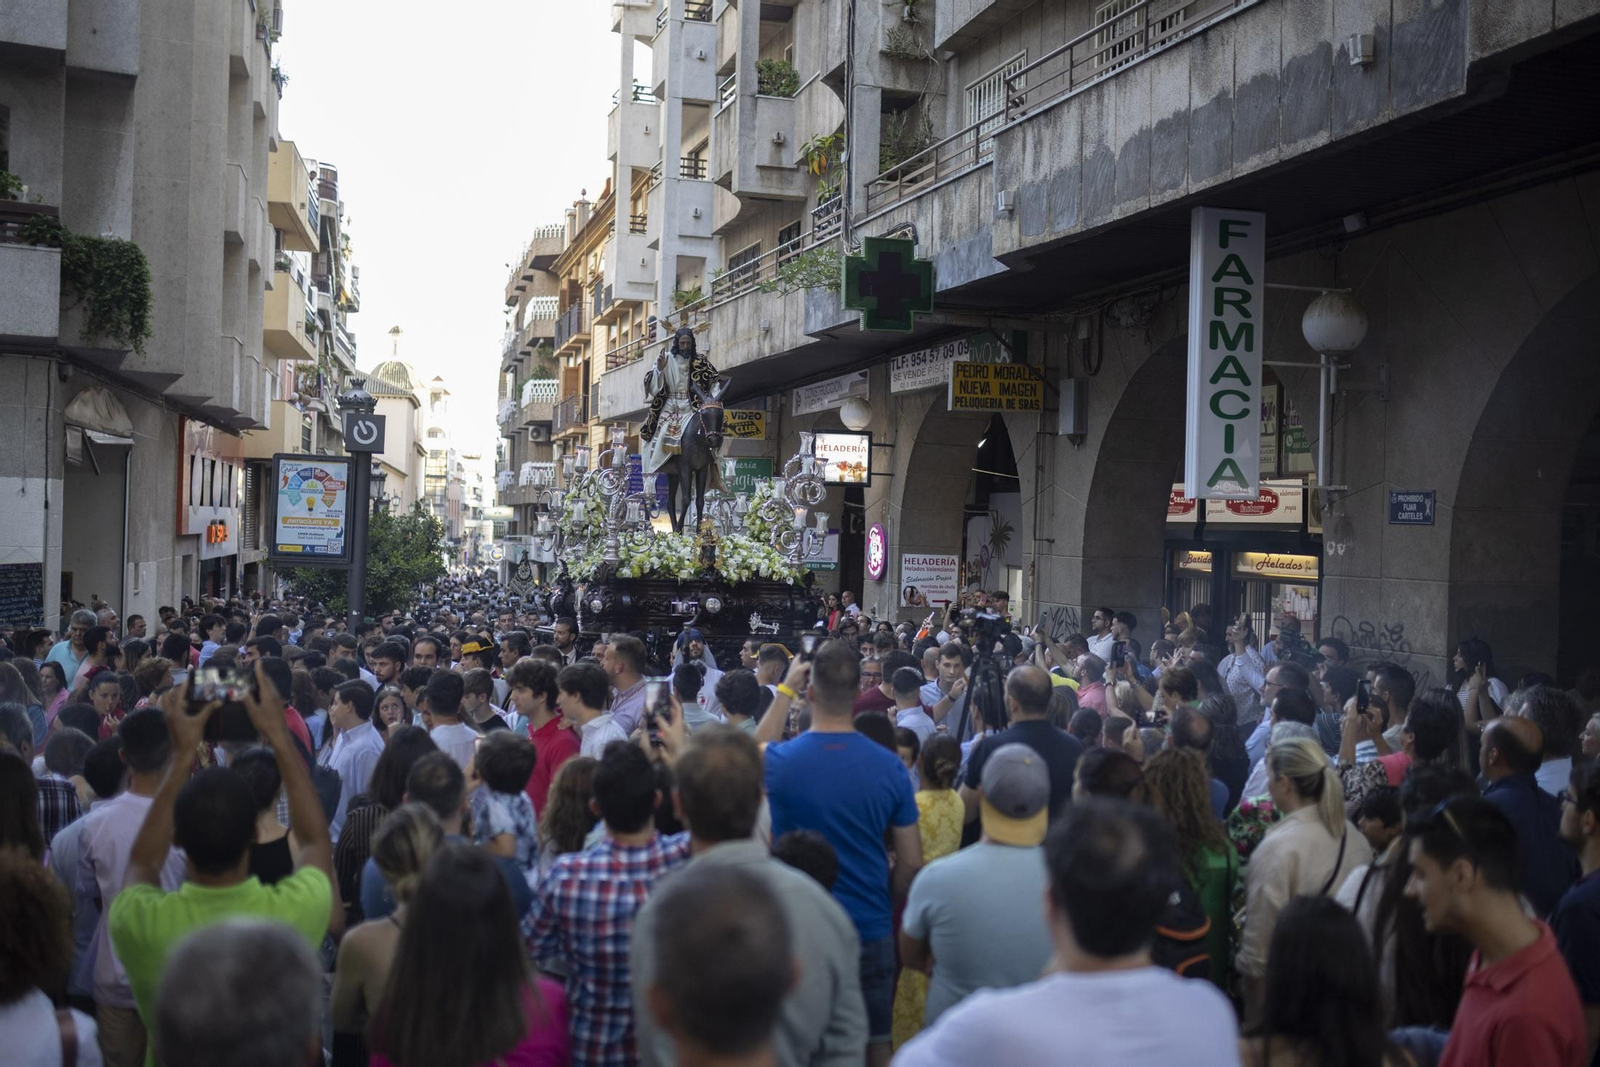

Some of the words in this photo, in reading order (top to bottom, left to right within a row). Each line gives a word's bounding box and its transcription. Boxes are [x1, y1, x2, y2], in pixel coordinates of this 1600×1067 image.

[891, 358, 909, 371] TLF:
[911, 353, 926, 367] 954
[929, 350, 940, 362] 57
[943, 345, 955, 359] 09
[957, 341, 969, 356] 09
[1206, 219, 1254, 489] FARMACIA
[893, 372, 902, 382] SE
[903, 368, 926, 380] VENDE
[956, 364, 989, 379] PEDRO
[994, 366, 1042, 381] MORALES
[959, 381, 991, 395] NUEVA
[1000, 382, 1037, 397] IMAGEN
[955, 396, 1001, 409] PELUQUERIA
[1006, 399, 1016, 409] DE
[1018, 399, 1041, 411] SRAS.
[735, 424, 757, 434] CLUB
[816, 442, 867, 453] HELADERÍA
[1397, 494, 1424, 502] PROHIBIDO
[1403, 503, 1417, 511] FIJAR
[1397, 512, 1424, 520] CARTELES
[904, 556, 956, 566] HELADERÍA
[1256, 555, 1303, 570] Helados
